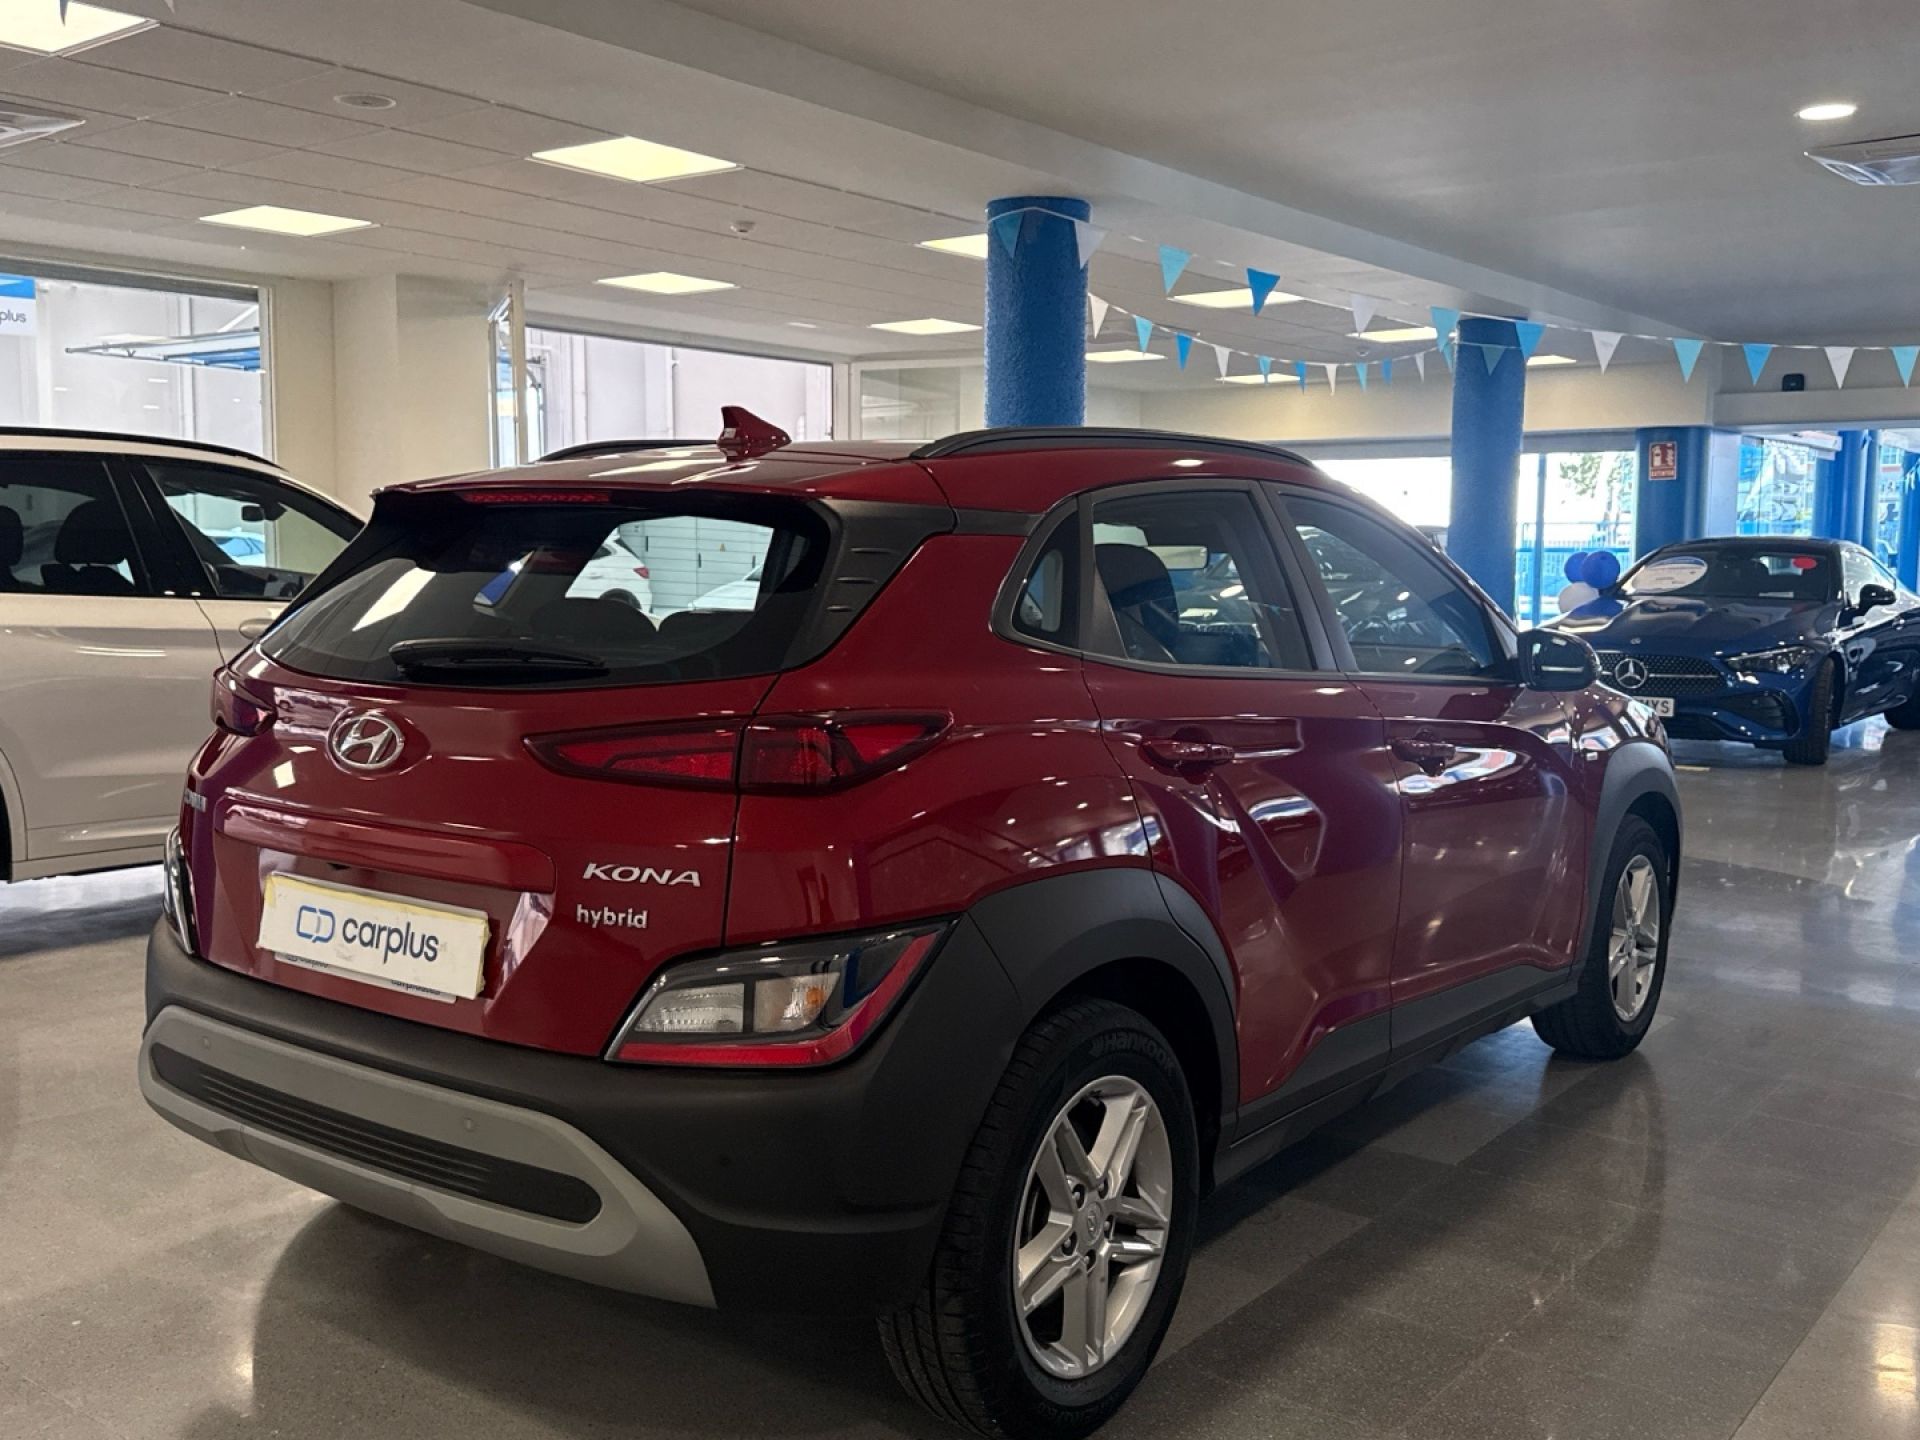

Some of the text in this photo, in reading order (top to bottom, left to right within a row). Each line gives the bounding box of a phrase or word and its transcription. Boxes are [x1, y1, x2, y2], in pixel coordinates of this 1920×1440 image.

[583, 862, 701, 887] KONA
[576, 904, 648, 929] hybrid
[342, 917, 440, 965] carplus
